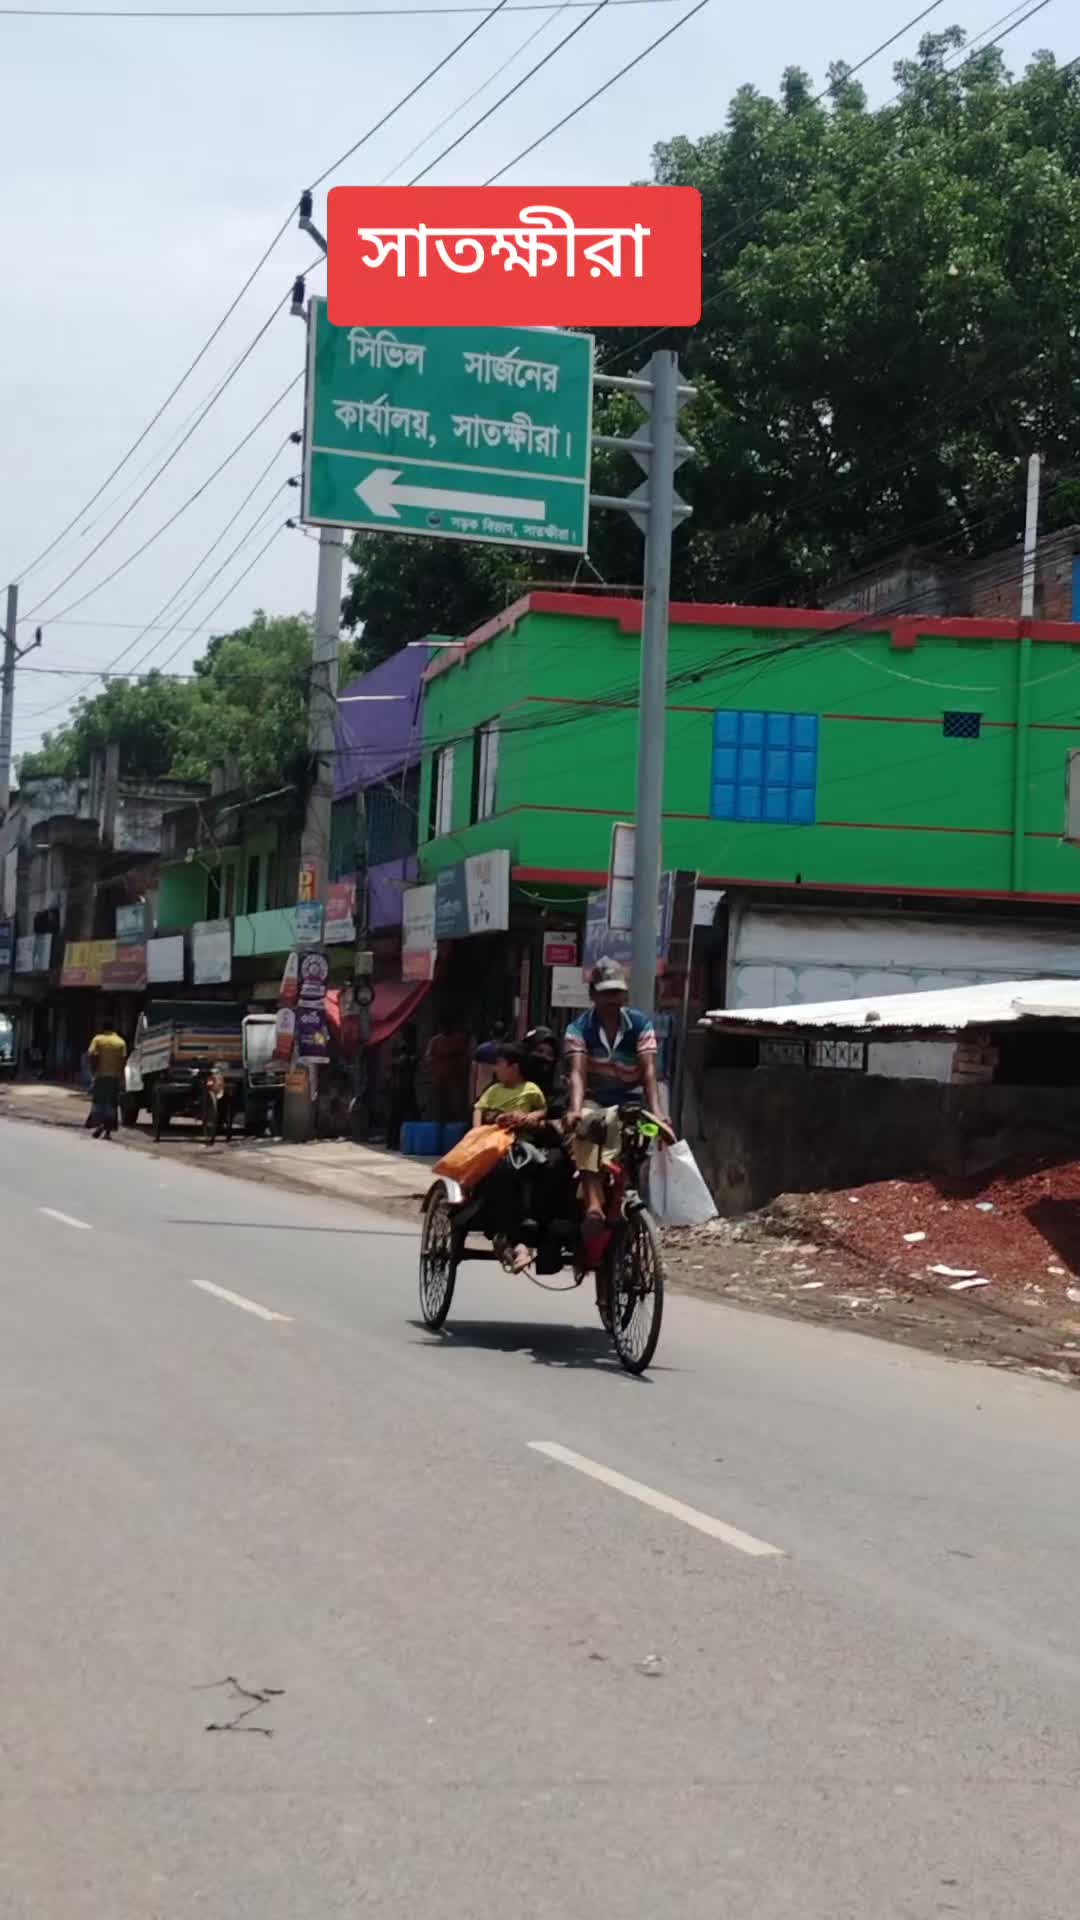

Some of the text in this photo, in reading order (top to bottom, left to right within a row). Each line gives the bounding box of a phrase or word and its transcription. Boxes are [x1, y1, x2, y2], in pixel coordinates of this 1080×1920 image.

[348, 328, 560, 393] সিভিল সার্জনের
[333, 395, 437, 447] কার্যালয়,
